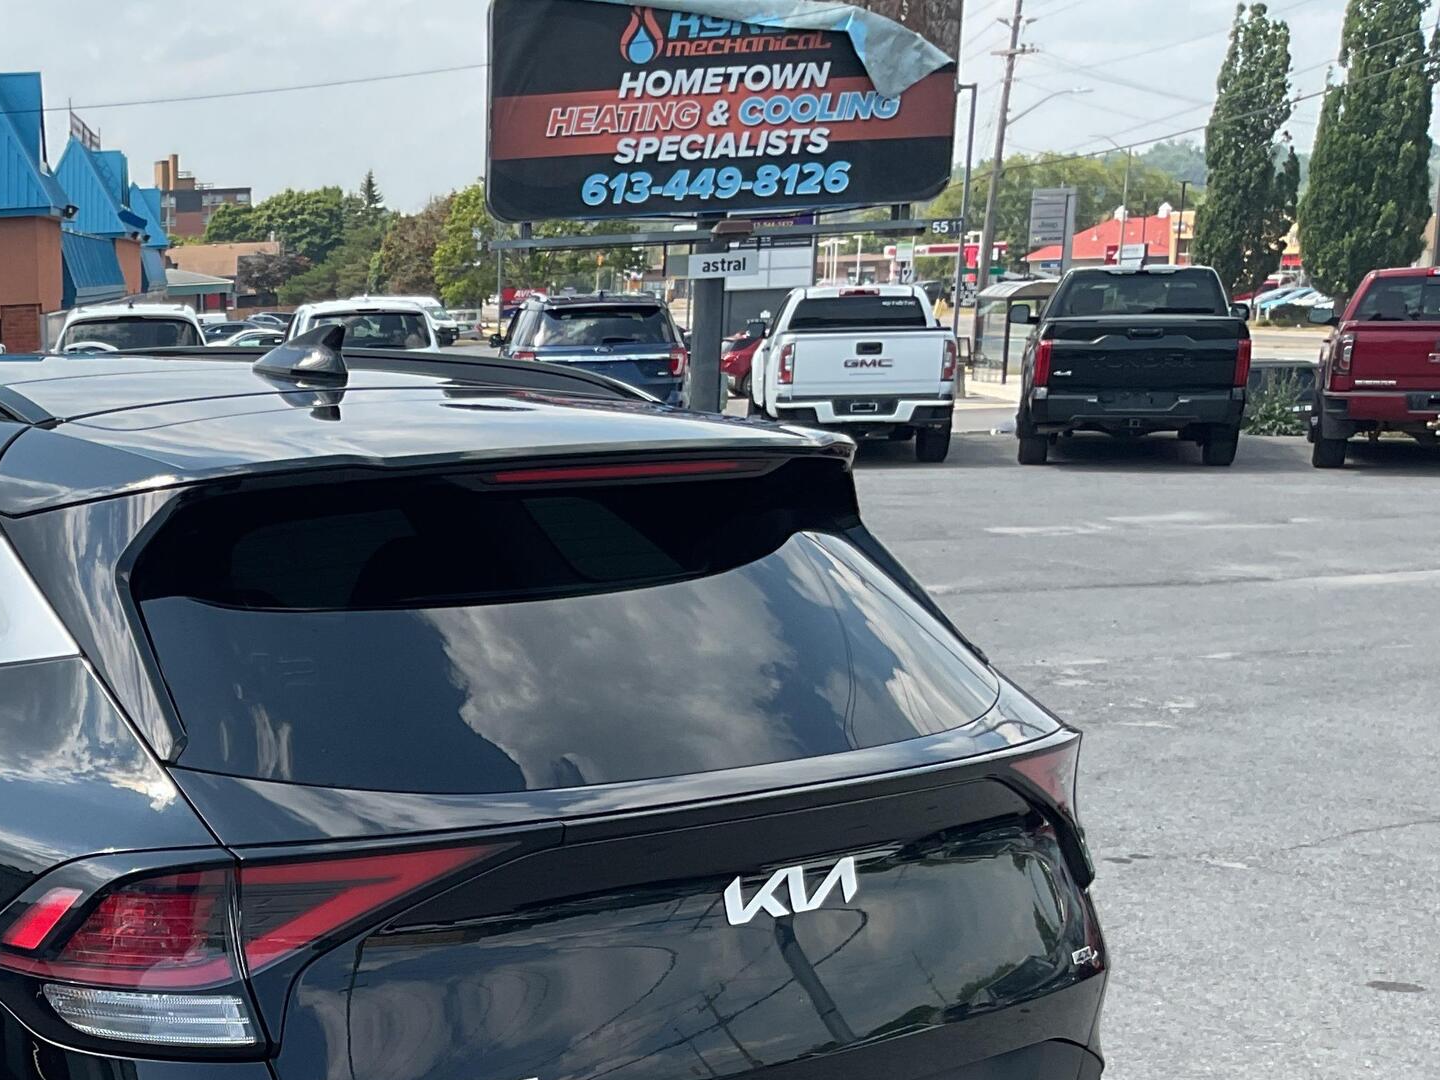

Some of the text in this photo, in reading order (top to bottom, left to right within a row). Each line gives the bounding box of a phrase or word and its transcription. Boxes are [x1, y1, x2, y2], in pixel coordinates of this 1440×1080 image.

[618, 61, 831, 99] HOMETOWN
[546, 92, 901, 137] HEATING & COOLING
[614, 127, 830, 165] SPECIALISTS
[581, 161, 852, 206] 613-449-8126
[702, 257, 747, 273] astral
[844, 358, 894, 368] GMC
[724, 856, 858, 926] KIA
